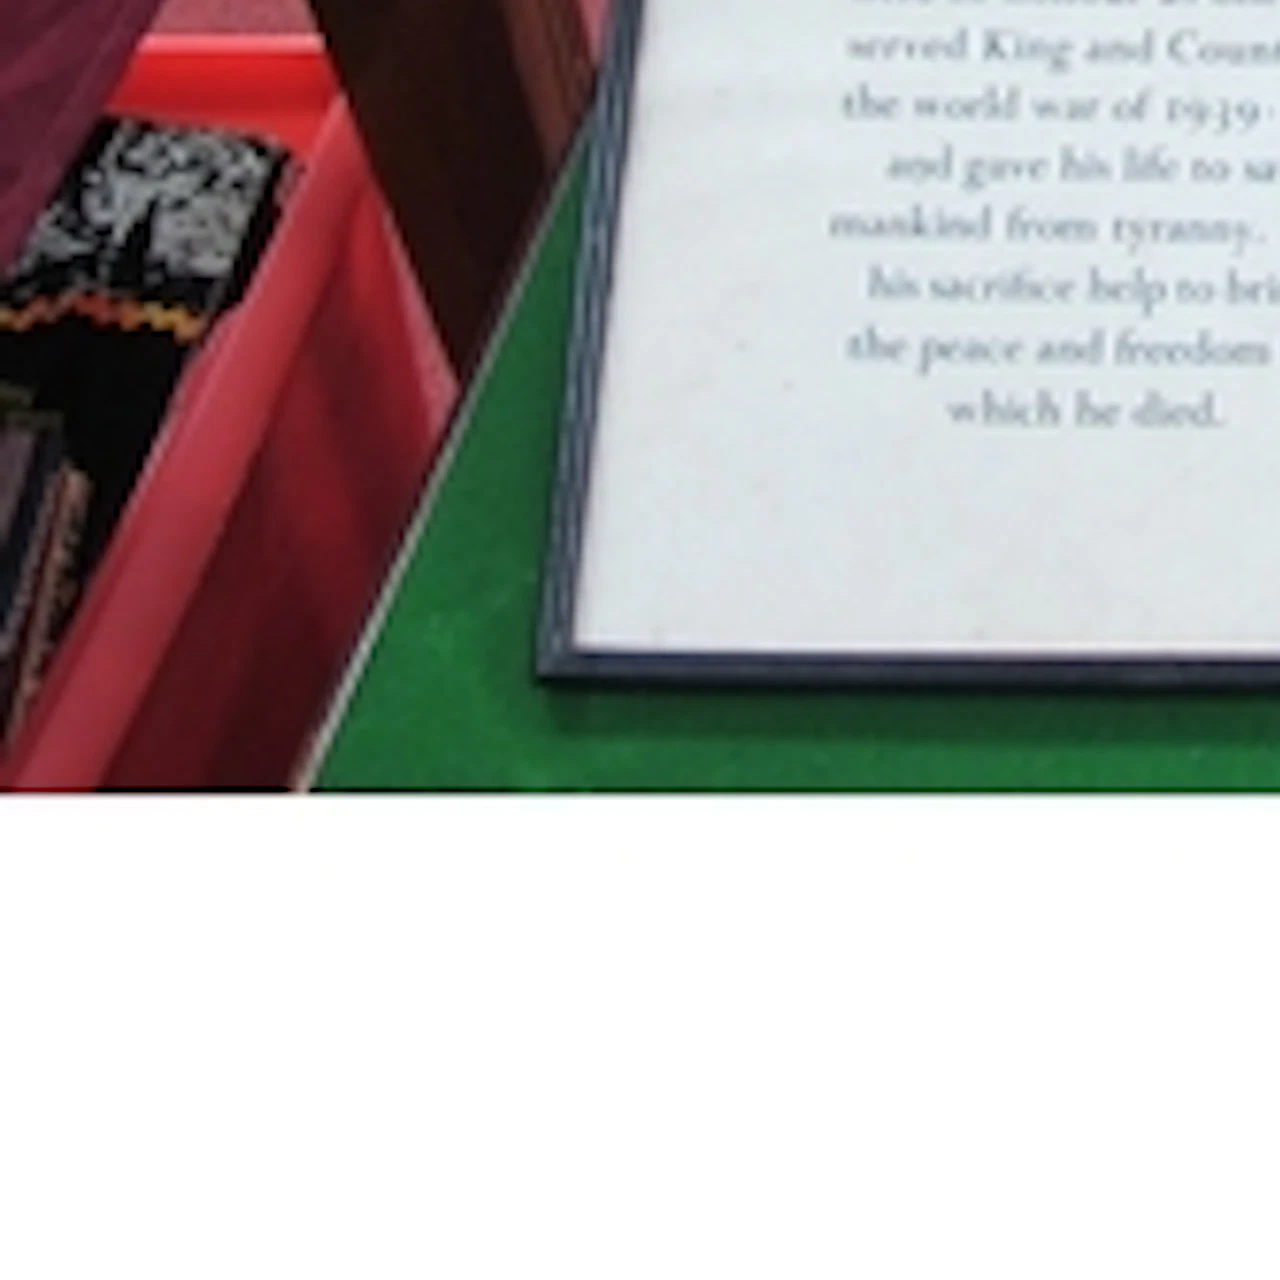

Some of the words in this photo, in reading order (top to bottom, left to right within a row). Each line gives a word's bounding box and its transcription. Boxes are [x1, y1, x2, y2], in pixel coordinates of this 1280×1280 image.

[847, 26, 969, 61] served
[982, 28, 1073, 74] King
[1083, 27, 1156, 65] and
[841, 82, 900, 120] the
[913, 85, 1021, 121] world
[1031, 97, 1101, 122] war
[1111, 90, 1150, 122] of
[886, 143, 954, 181] and
[961, 156, 1049, 193] gave
[1059, 144, 1113, 182] his
[1122, 145, 1180, 183] life
[1190, 157, 1233, 183] to
[828, 203, 993, 241] mankind
[1005, 205, 1099, 242] from
[867, 264, 921, 300] his
[928, 269, 1076, 303] sacrifice
[1087, 265, 1169, 319] help
[1174, 277, 1218, 305] to
[847, 324, 907, 362] the
[917, 337, 1023, 377] peace
[1035, 328, 1105, 366] and
[1113, 327, 1272, 367] freedom
[947, 388, 1062, 428] which
[1074, 389, 1121, 429] he
